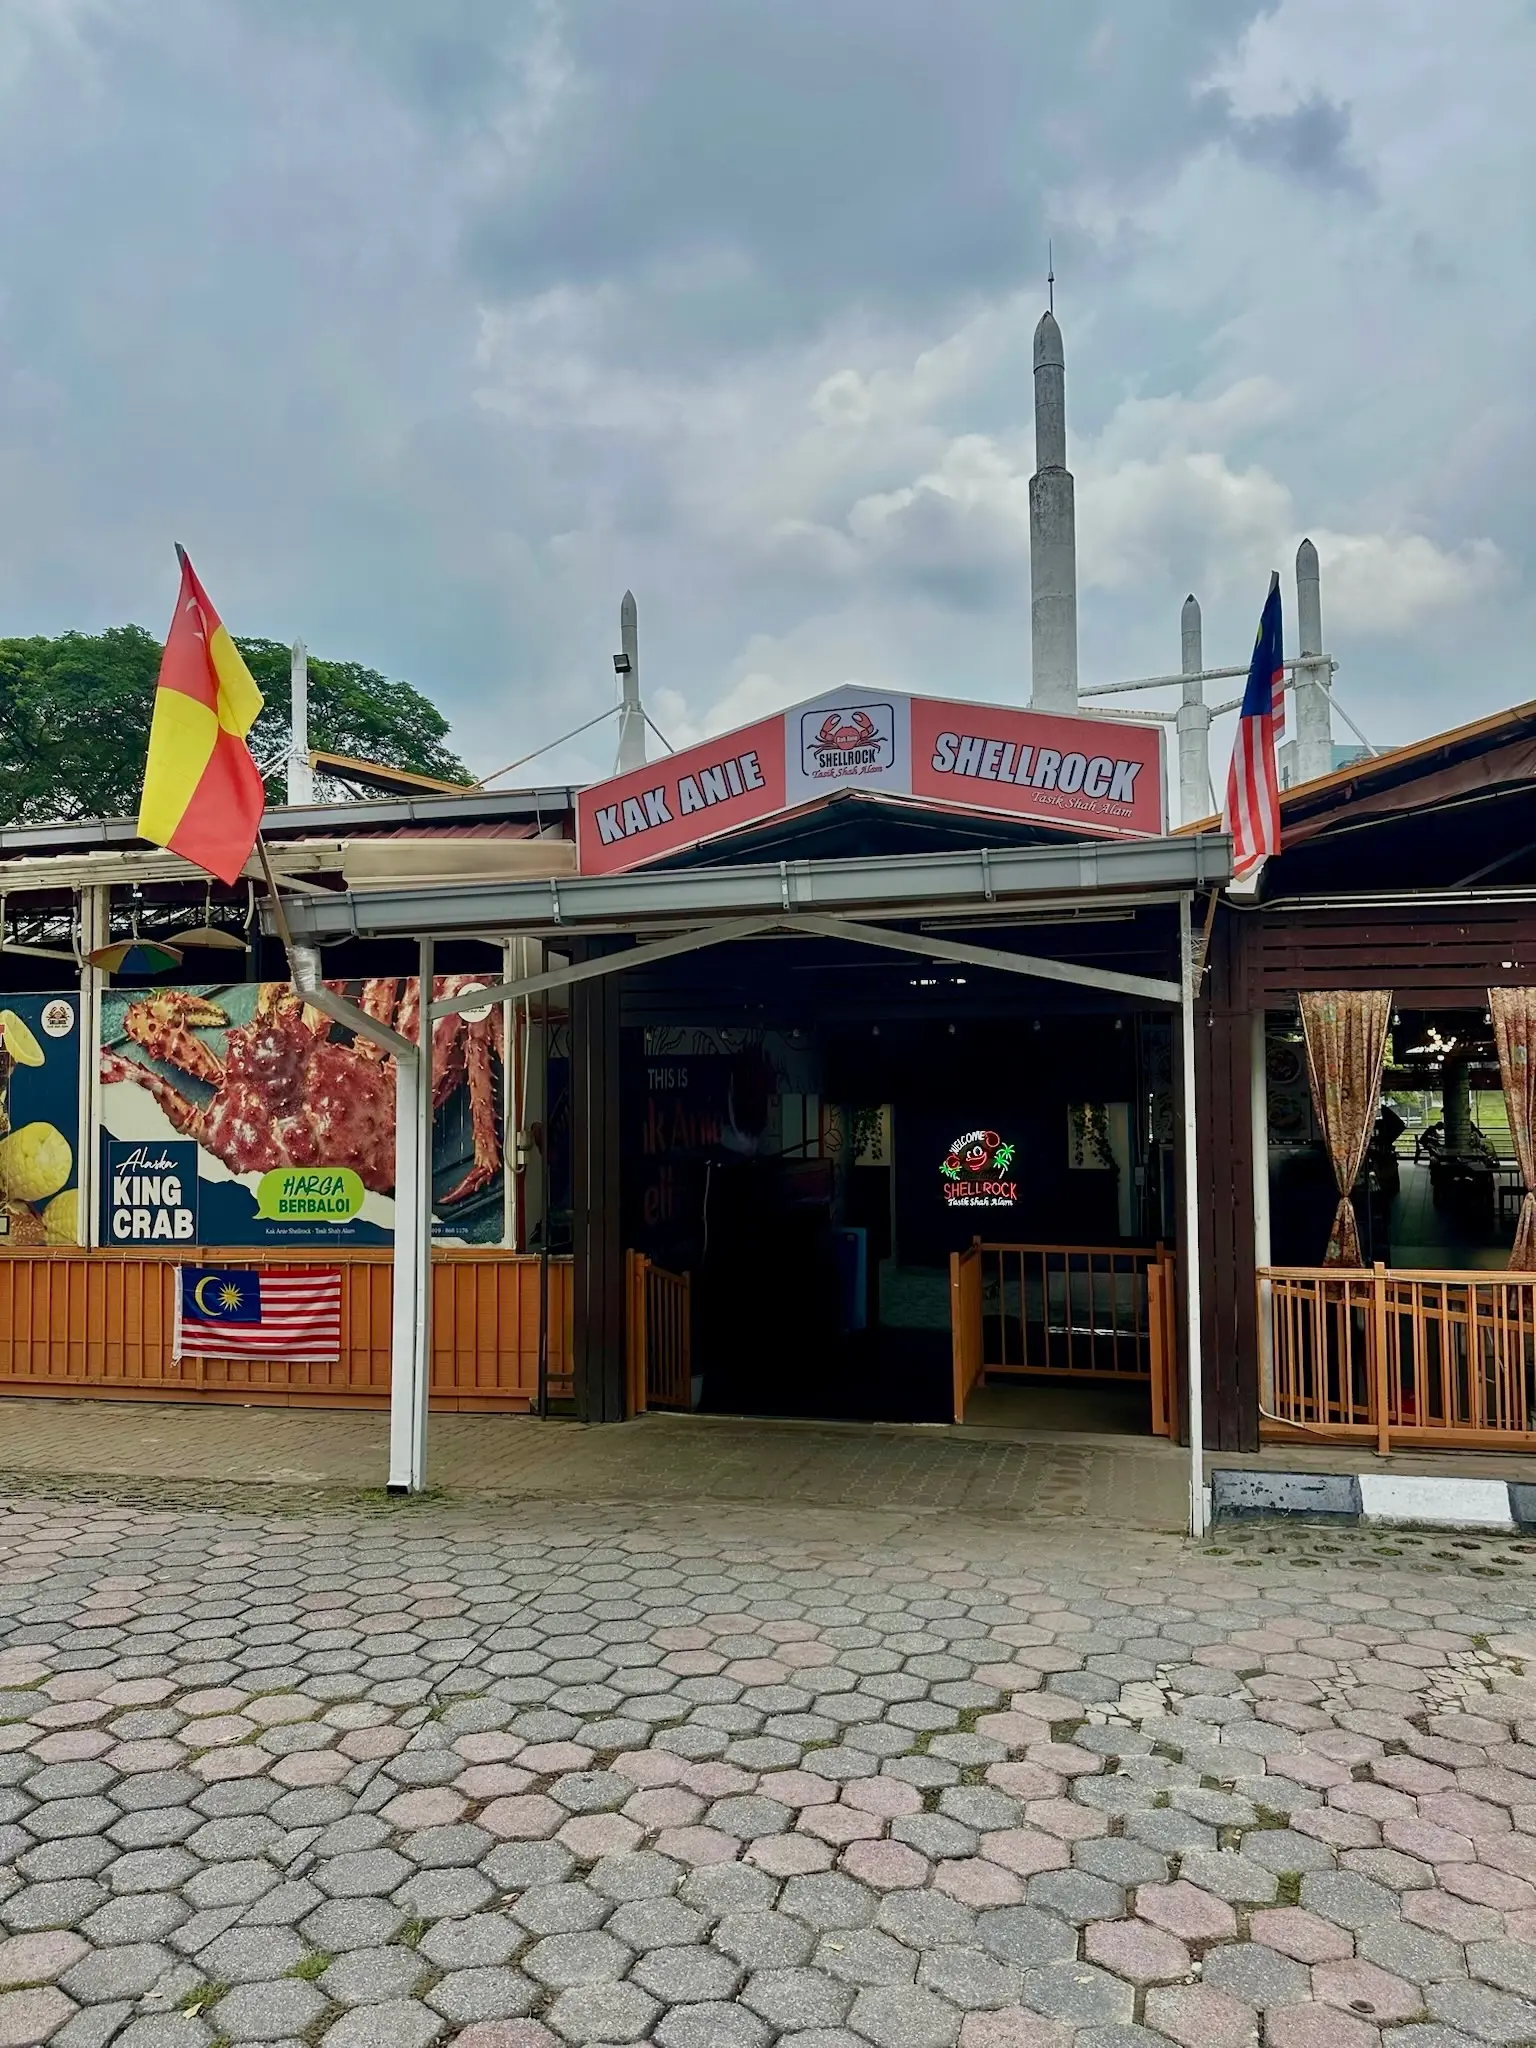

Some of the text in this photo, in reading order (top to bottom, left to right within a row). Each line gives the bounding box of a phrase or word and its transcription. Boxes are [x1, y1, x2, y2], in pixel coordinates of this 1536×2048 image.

[819, 749, 876, 769] SHELLROCK
[930, 731, 1144, 804] SHELLROCK
[811, 764, 883, 779] Tasik Shah Alam
[594, 750, 766, 846] KAK ANIE
[1031, 790, 1133, 818] Tasik Shah Alam
[648, 1067, 688, 1090] THIS IS
[949, 1130, 986, 1155] WELCOME
[115, 1146, 179, 1176] Alaska
[113, 1175, 182, 1206] KING
[283, 1175, 345, 1197] HARGA
[943, 1181, 1017, 1201] SHELLROCK
[279, 1198, 350, 1213] BERBALOI
[947, 1197, 1014, 1207] Tasik Shah Alam
[112, 1208, 195, 1239] CRAB
